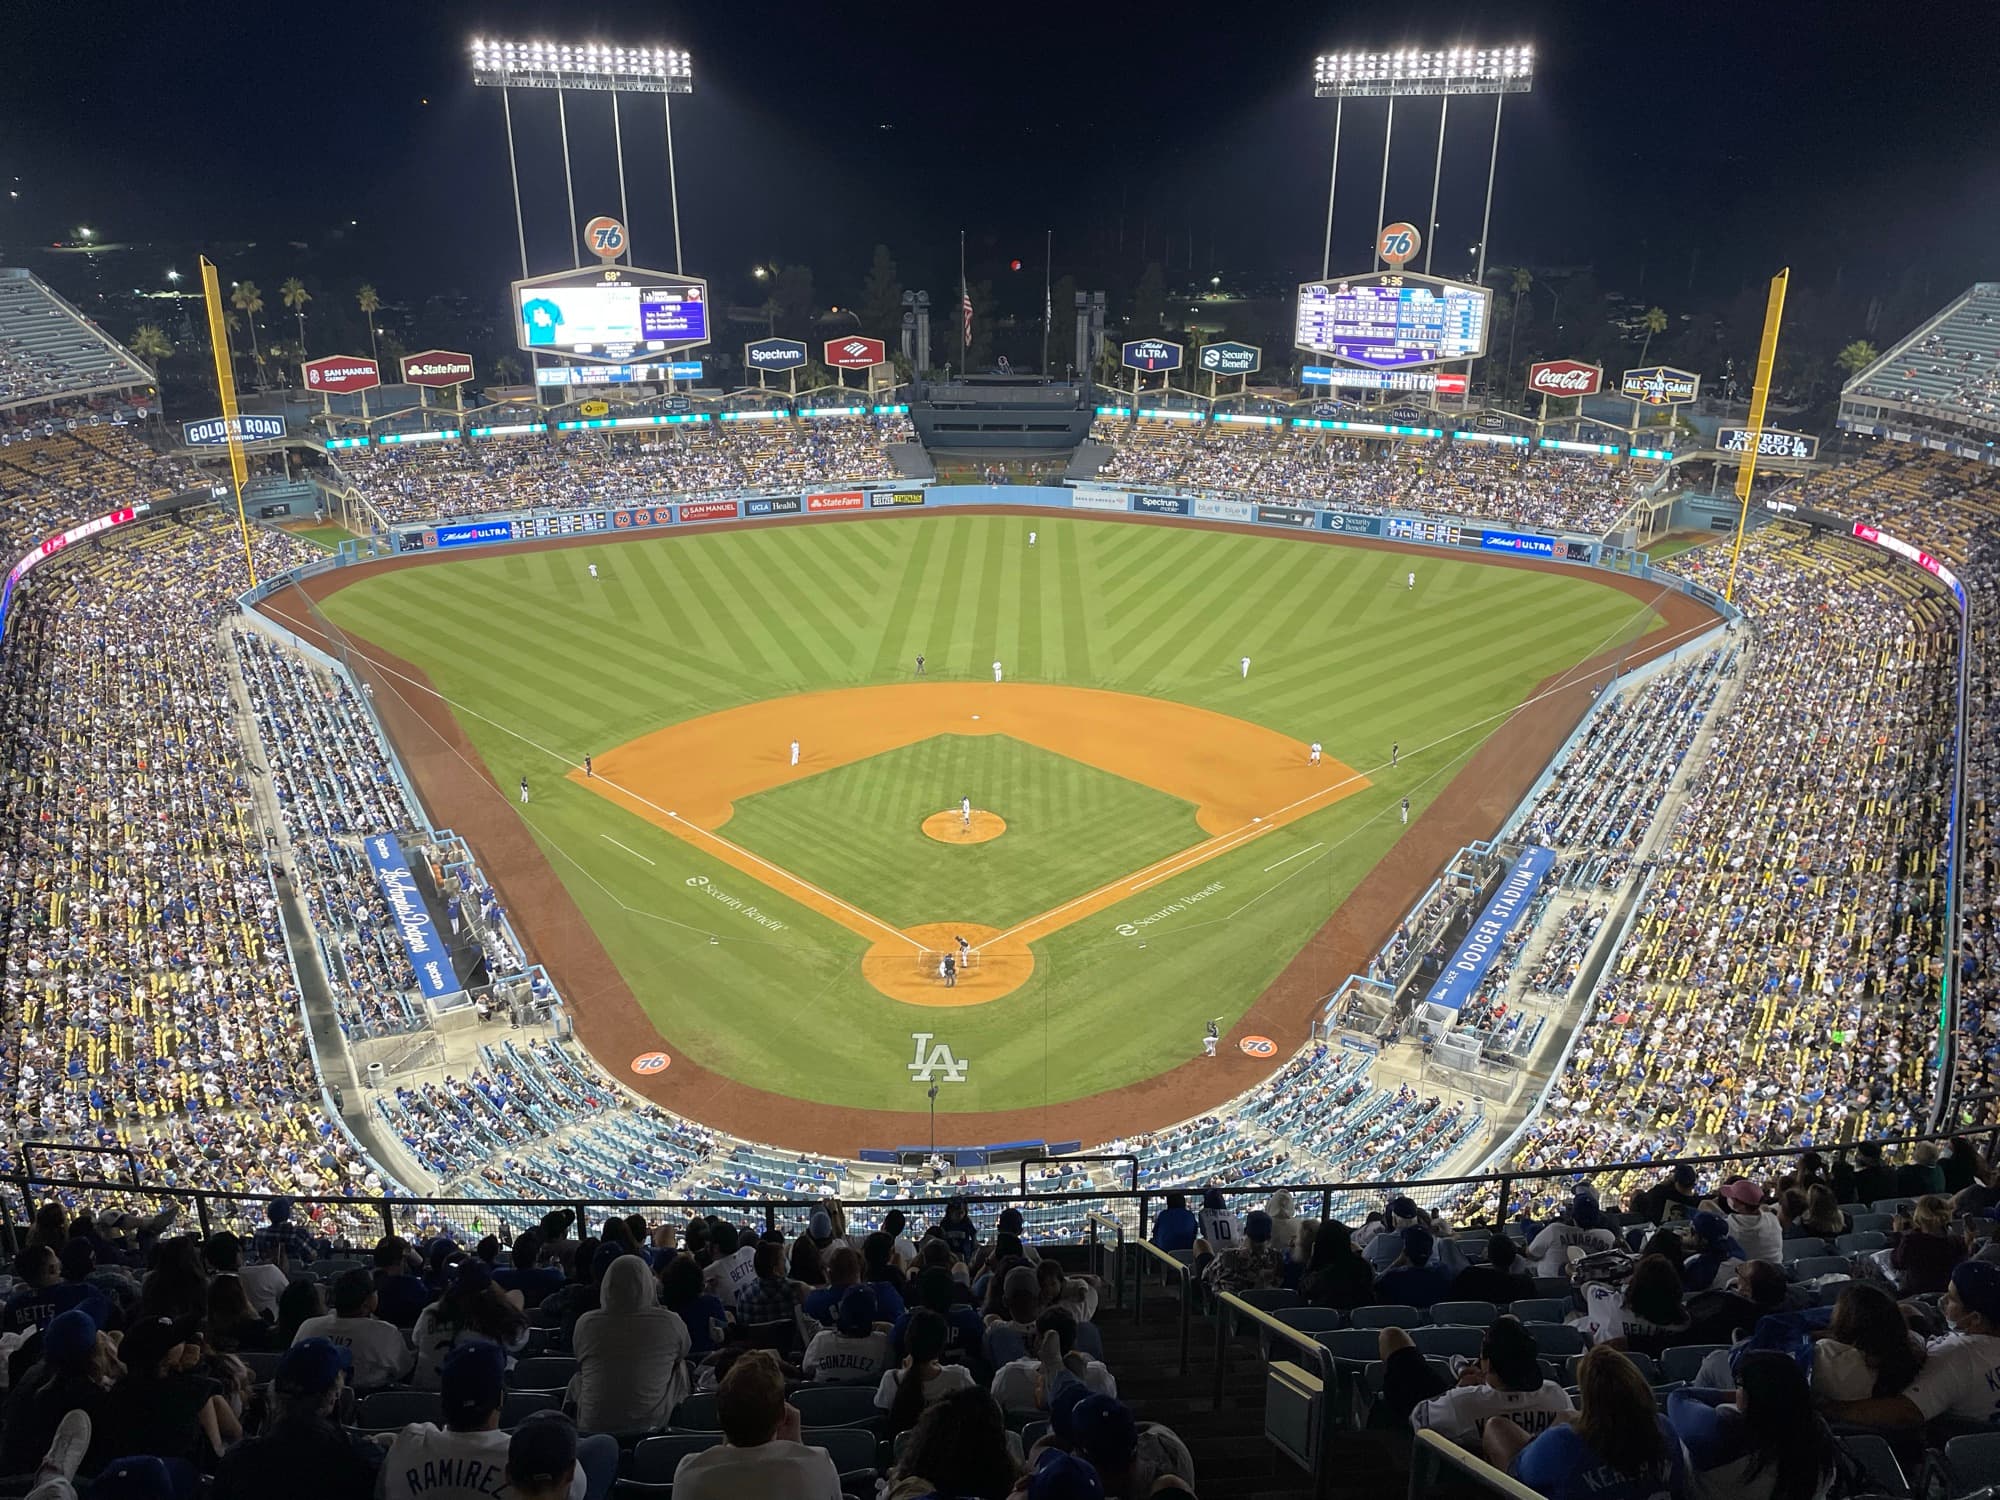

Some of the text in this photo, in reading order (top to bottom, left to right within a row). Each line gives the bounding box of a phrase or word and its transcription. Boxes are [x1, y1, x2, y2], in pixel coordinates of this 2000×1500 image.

[594, 225, 624, 250] 76
[1383, 231, 1413, 256] 76
[752, 350, 799, 362] Spectrum
[1135, 350, 1168, 359] ULTRA
[1222, 350, 1254, 361] Security
[1222, 360, 1249, 369] Benefit
[343, 367, 375, 376] MANUEL
[1665, 382, 1693, 394] GAME
[245, 419, 281, 435] ROAD
[705, 504, 736, 512] MANUEL
[772, 501, 797, 510] Health
[1142, 497, 1178, 507] Spectrum
[639, 513, 648, 521] 76
[658, 511, 667, 519] 76
[1345, 517, 1371, 527] Security
[478, 528, 508, 537] ULTRA
[1522, 541, 1552, 552] ULTRA
[701, 884, 783, 931] Security Benefit
[1133, 881, 1225, 928] Security Benefit
[1456, 870, 1535, 972] DODGER STADIUM
[400, 913, 431, 954] Dodgers
[424, 961, 445, 990] Spectrum
[1245, 1041, 1272, 1053] 76
[638, 1055, 665, 1070] 76
[908, 1033, 968, 1082] LA
[1212, 1220, 1231, 1240] 10
[730, 1260, 753, 1281] BETTS
[15, 1303, 56, 1325] BETTS
[819, 1354, 874, 1371] GONZALEZ
